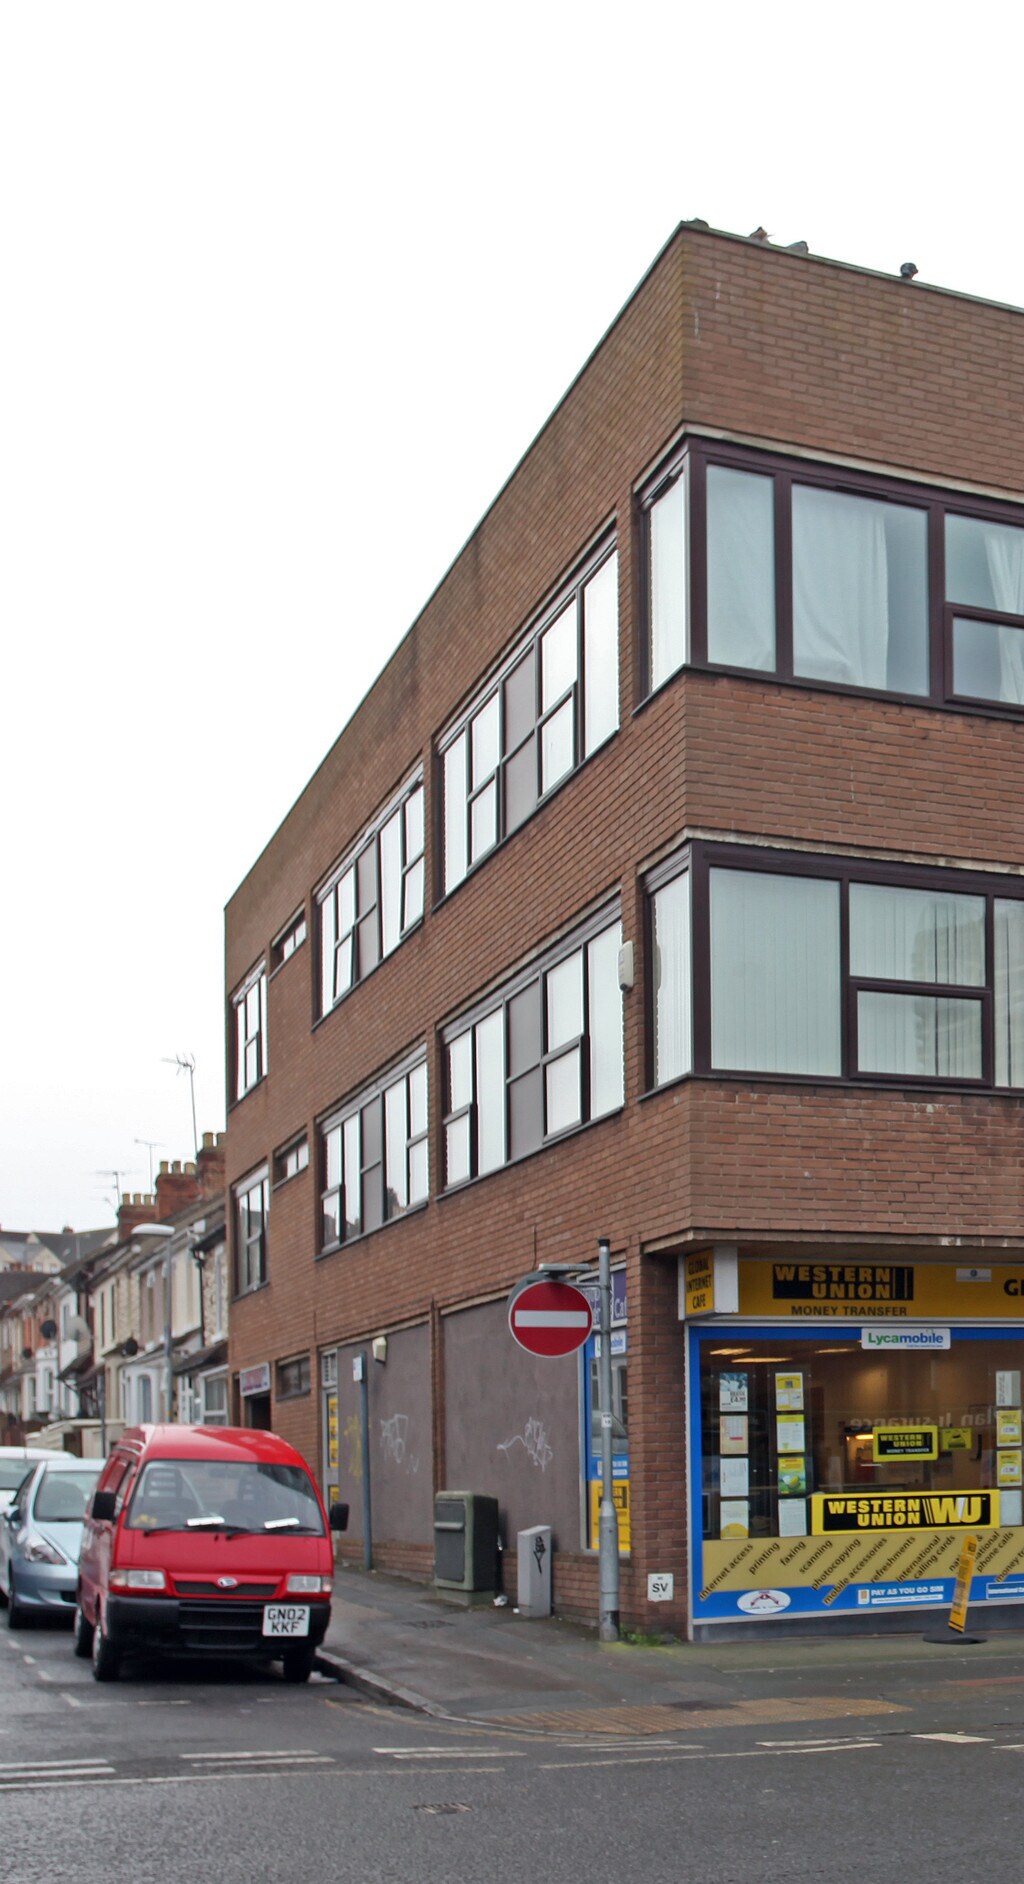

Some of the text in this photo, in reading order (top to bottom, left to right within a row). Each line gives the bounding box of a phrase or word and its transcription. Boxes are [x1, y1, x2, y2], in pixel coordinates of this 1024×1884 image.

[775, 1266, 890, 1282] WESTERN
[692, 1293, 707, 1309] CAFE
[812, 1283, 890, 1299] UNION
[791, 1306, 907, 1316] MONEY TRANSFER
[868, 1332, 944, 1345] Lycamobile
[828, 1499, 920, 1514] WESTERN
[857, 1512, 920, 1526] UNION
[930, 1497, 982, 1524] WU
[730, 1544, 754, 1570] access
[748, 1542, 781, 1575] printing
[780, 1540, 807, 1567] faxing
[799, 1539, 833, 1574] scanning
[811, 1538, 861, 1591] photocopying
[870, 1536, 916, 1584] refreshments
[896, 1535, 941, 1583] international
[913, 1554, 939, 1580] calling
[936, 1535, 956, 1560] cards
[976, 1531, 1014, 1573] phone calls
[823, 1537, 887, 1605] mobile accessories
[995, 1556, 1020, 1583] money
[652, 1583, 668, 1593] SV
[267, 1608, 306, 1620] GN02
[272, 1621, 300, 1633] KKF
